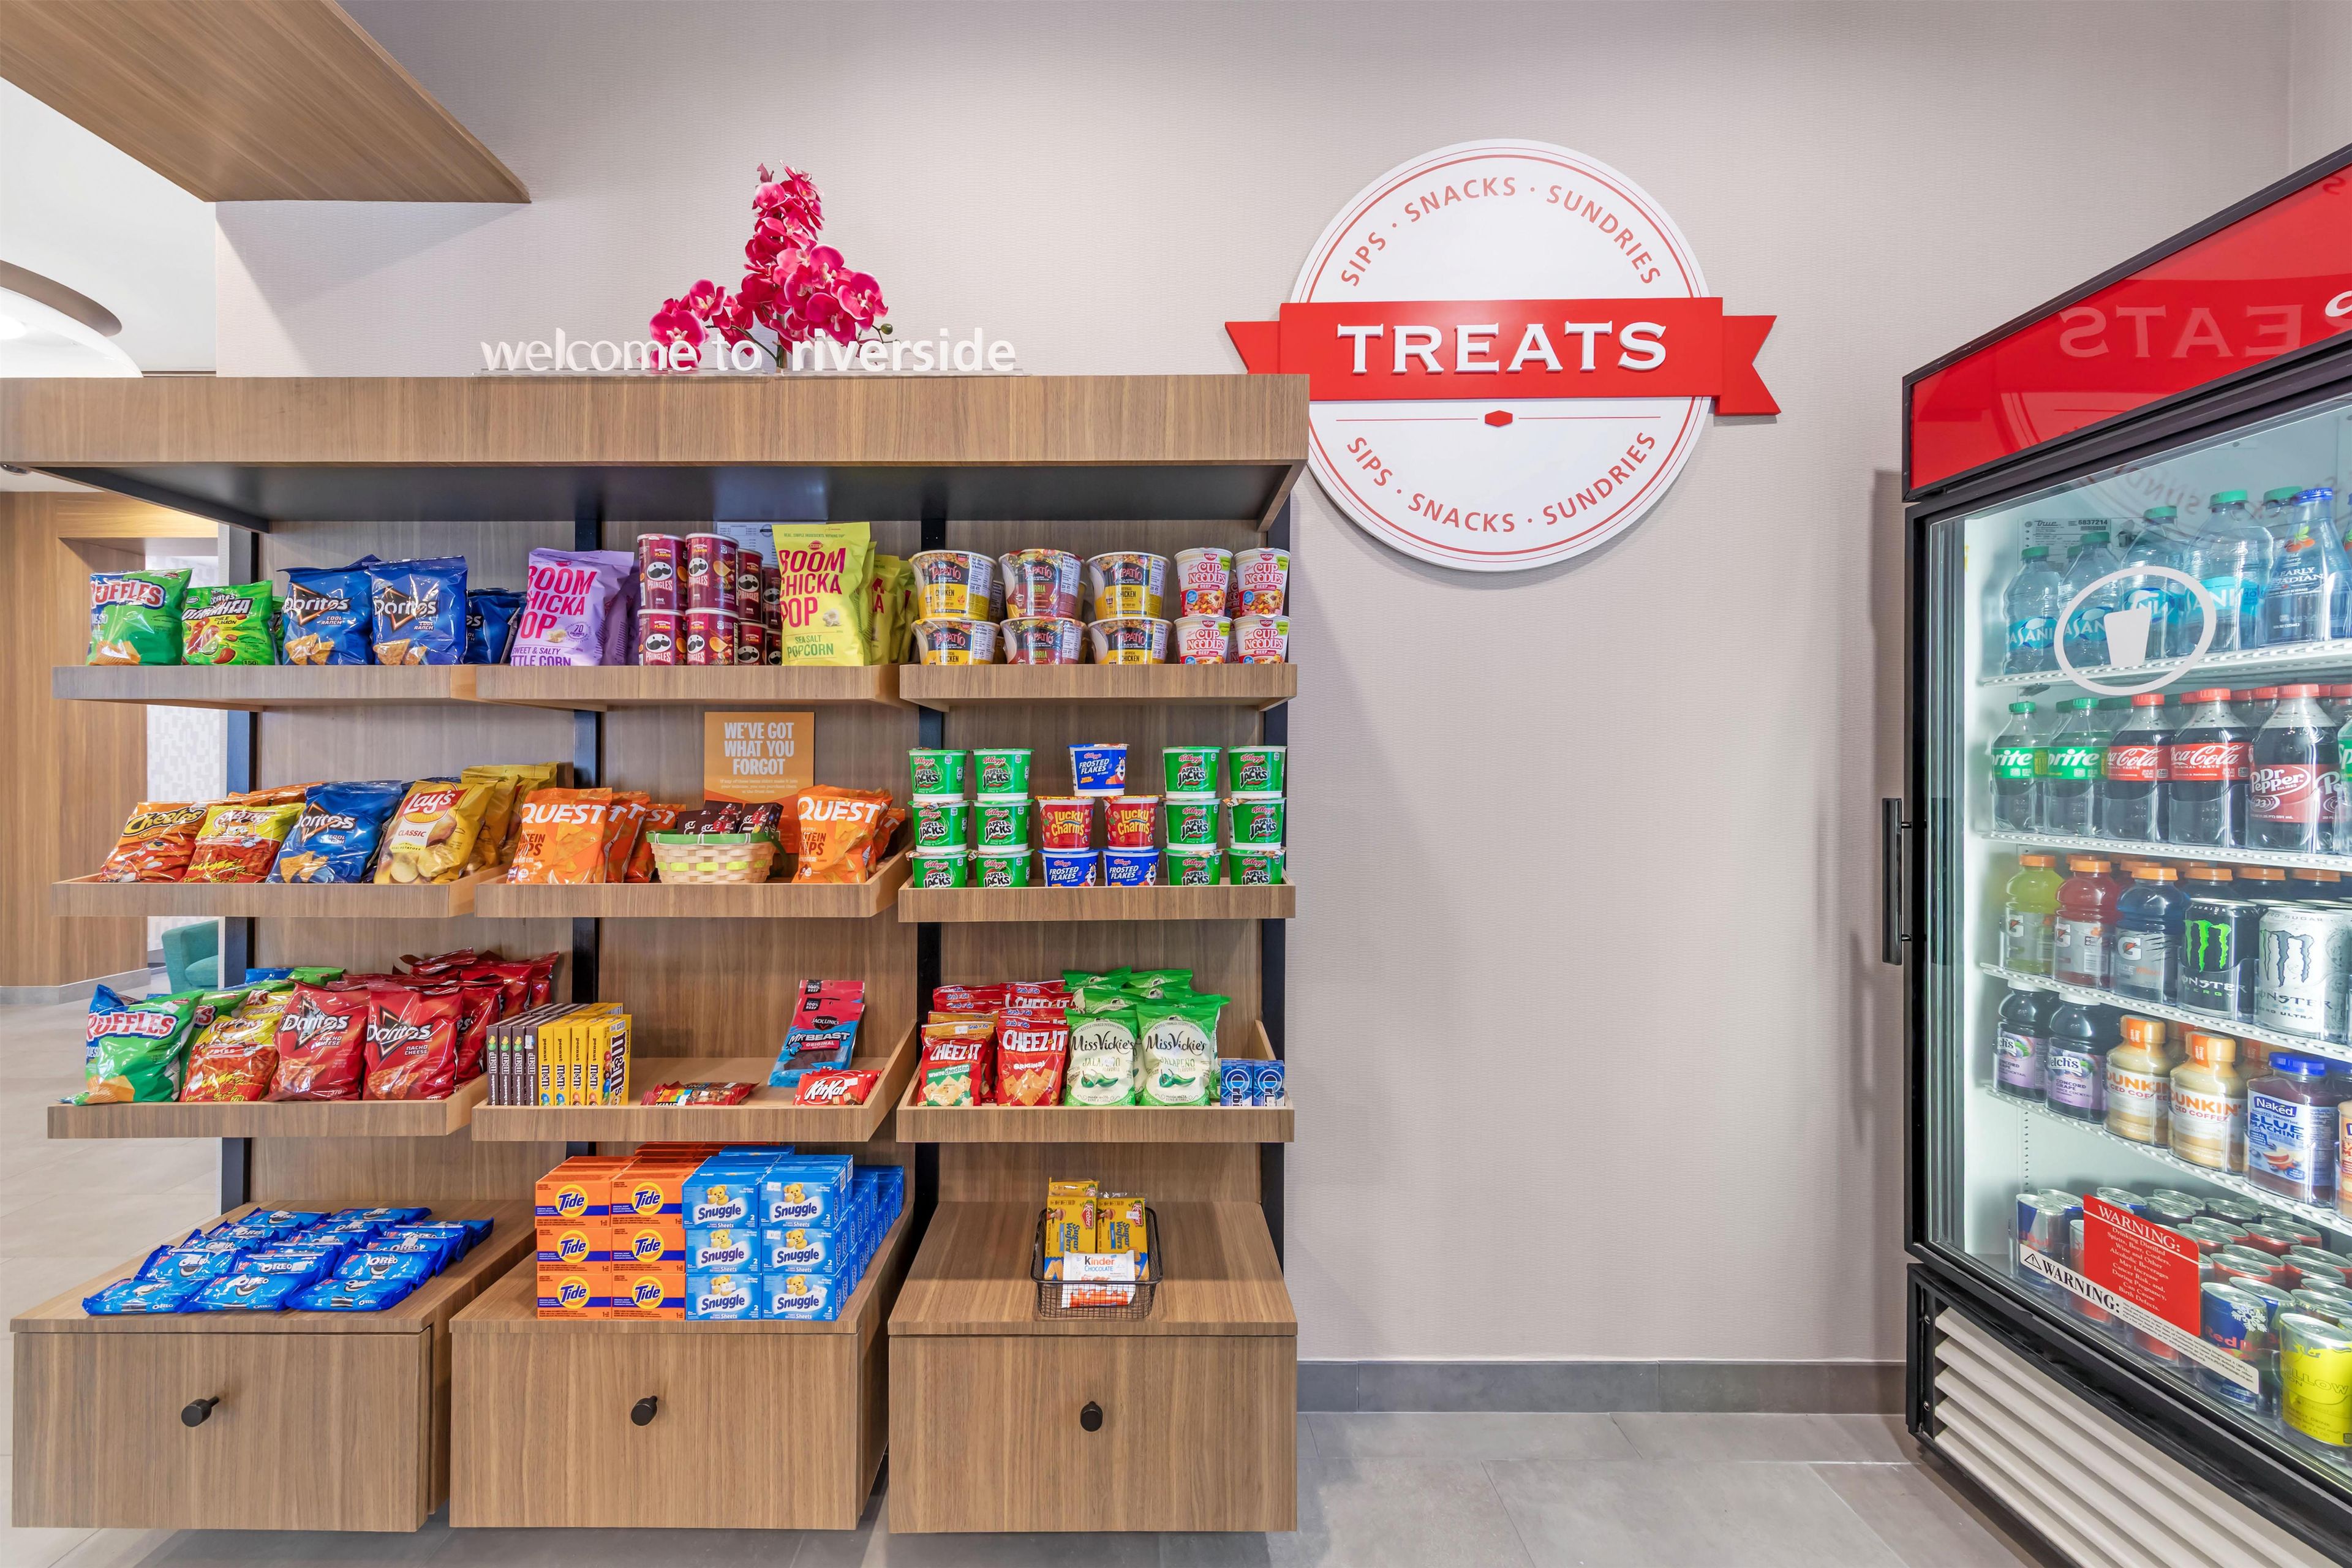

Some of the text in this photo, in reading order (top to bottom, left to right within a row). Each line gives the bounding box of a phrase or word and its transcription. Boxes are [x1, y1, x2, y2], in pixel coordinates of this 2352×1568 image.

[1341, 176, 1661, 286] SIPS SNACKS SUNDRIES
[480, 327, 1017, 372] welcome to riverside
[1338, 321, 1667, 374] TREATS
[1347, 432, 1656, 533] SIPS SNACKS SUNDRIES
[778, 548, 846, 575] BOOM
[1196, 562, 1222, 574] CUP
[1253, 562, 1279, 574] CUP
[647, 579, 673, 591] PRINGLES
[780, 573, 842, 598] CHICKA
[1188, 573, 1226, 585] NOODLES
[1245, 573, 1284, 586] NOODLES
[738, 589, 760, 602] PRINGLES
[284, 597, 349, 612] Doritos
[374, 599, 437, 616] Doritos
[780, 596, 818, 629] POP
[1195, 628, 1221, 639] CUP
[1253, 628, 1279, 639] CUP
[787, 643, 834, 658] POPCORN
[1187, 639, 1226, 650] NOODLES
[1245, 639, 1284, 650] NOODLES
[646, 652, 671, 663] PRINGLES
[724, 722, 794, 739] WE'VE GOT
[724, 740, 794, 757] WHAT YOU
[913, 756, 935, 764] Kellogg's
[982, 755, 1006, 764] Kellogg's
[1079, 758, 1110, 769] FROSTED
[1178, 753, 1203, 762] Kellogg's
[733, 758, 786, 775] FORGOT
[1080, 766, 1107, 775] FLAKES
[2260, 768, 2285, 782] Dr
[914, 774, 938, 790] JACKS
[982, 774, 1009, 790] JACKS
[1177, 772, 1205, 789] JACKS
[1240, 772, 1268, 789] JACKS
[2250, 771, 2305, 794] Pepper
[404, 788, 455, 815] Lay's
[797, 797, 881, 823] QUEST
[2255, 798, 2267, 808] 23
[123, 807, 206, 836] Cheetos
[522, 803, 606, 824] QUEST
[1054, 810, 1084, 824] Lucky
[1120, 809, 1150, 823] Lucky
[398, 829, 427, 838] CLASSIC
[1051, 823, 1085, 837] Charms
[1117, 822, 1150, 836] Charms
[1049, 866, 1079, 875] FROSTED
[1051, 873, 1076, 881] FLAKES
[1109, 865, 1139, 874] FROSTED
[1110, 871, 1136, 880] FLAKES
[2006, 914, 2024, 938] G
[2056, 924, 2071, 948] G
[2117, 936, 2142, 960] G
[86, 1011, 176, 1041] RUFFLES
[281, 1014, 350, 1031] Doritos
[368, 1023, 432, 1041] Doritos
[1072, 1030, 1135, 1054] Miss Vickie's
[1145, 1030, 1207, 1055] Miss Vickie's
[944, 1064, 970, 1076] cheddar
[1159, 1057, 1196, 1068] JALAPEÑO
[804, 1080, 848, 1100] KitKat
[2056, 1078, 2087, 1089] CONCORD
[2056, 1083, 2076, 1091] GRAPE
[2250, 1112, 2304, 1135] BLUE
[2250, 1120, 2304, 1141] MACHINE
[558, 1193, 585, 1213] Tide
[634, 1190, 661, 1210] Tide
[698, 1204, 742, 1220] Snuggle
[774, 1202, 818, 1218] Snuggle
[1084, 1204, 1093, 1227] Keebler
[1121, 1223, 1131, 1248] Sugar
[2098, 1204, 2181, 1253] WARNING:
[1072, 1224, 1080, 1251] Sugar
[2112, 1227, 2166, 1256] Drinking Distilled
[560, 1238, 587, 1258] Tide
[634, 1237, 661, 1258] Tide
[701, 1248, 745, 1264] Snuggle
[777, 1248, 820, 1264] Snuggle
[2107, 1231, 2171, 1267] Spirits, Beer, Coolers,
[2115, 1242, 2163, 1269] Wine and Other
[260, 1262, 292, 1273] OREO
[368, 1256, 398, 1266] OREO
[1084, 1256, 1115, 1265] Kinder
[2109, 1247, 2169, 1280] Alcoholic Beverages
[2112, 1262, 2134, 1276] Cancer
[2119, 1258, 2159, 1282] May Increase
[2041, 1257, 2120, 1314] WARNING:
[2112, 1268, 2168, 1301] During Pregnancy,
[2123, 1281, 2155, 1302] Can Cause
[560, 1284, 587, 1304] Tide
[634, 1284, 661, 1304] Tide
[701, 1294, 745, 1311] Snuggle
[777, 1294, 820, 1310] Snuggle
[2119, 1285, 2160, 1312] Birth Defects.
